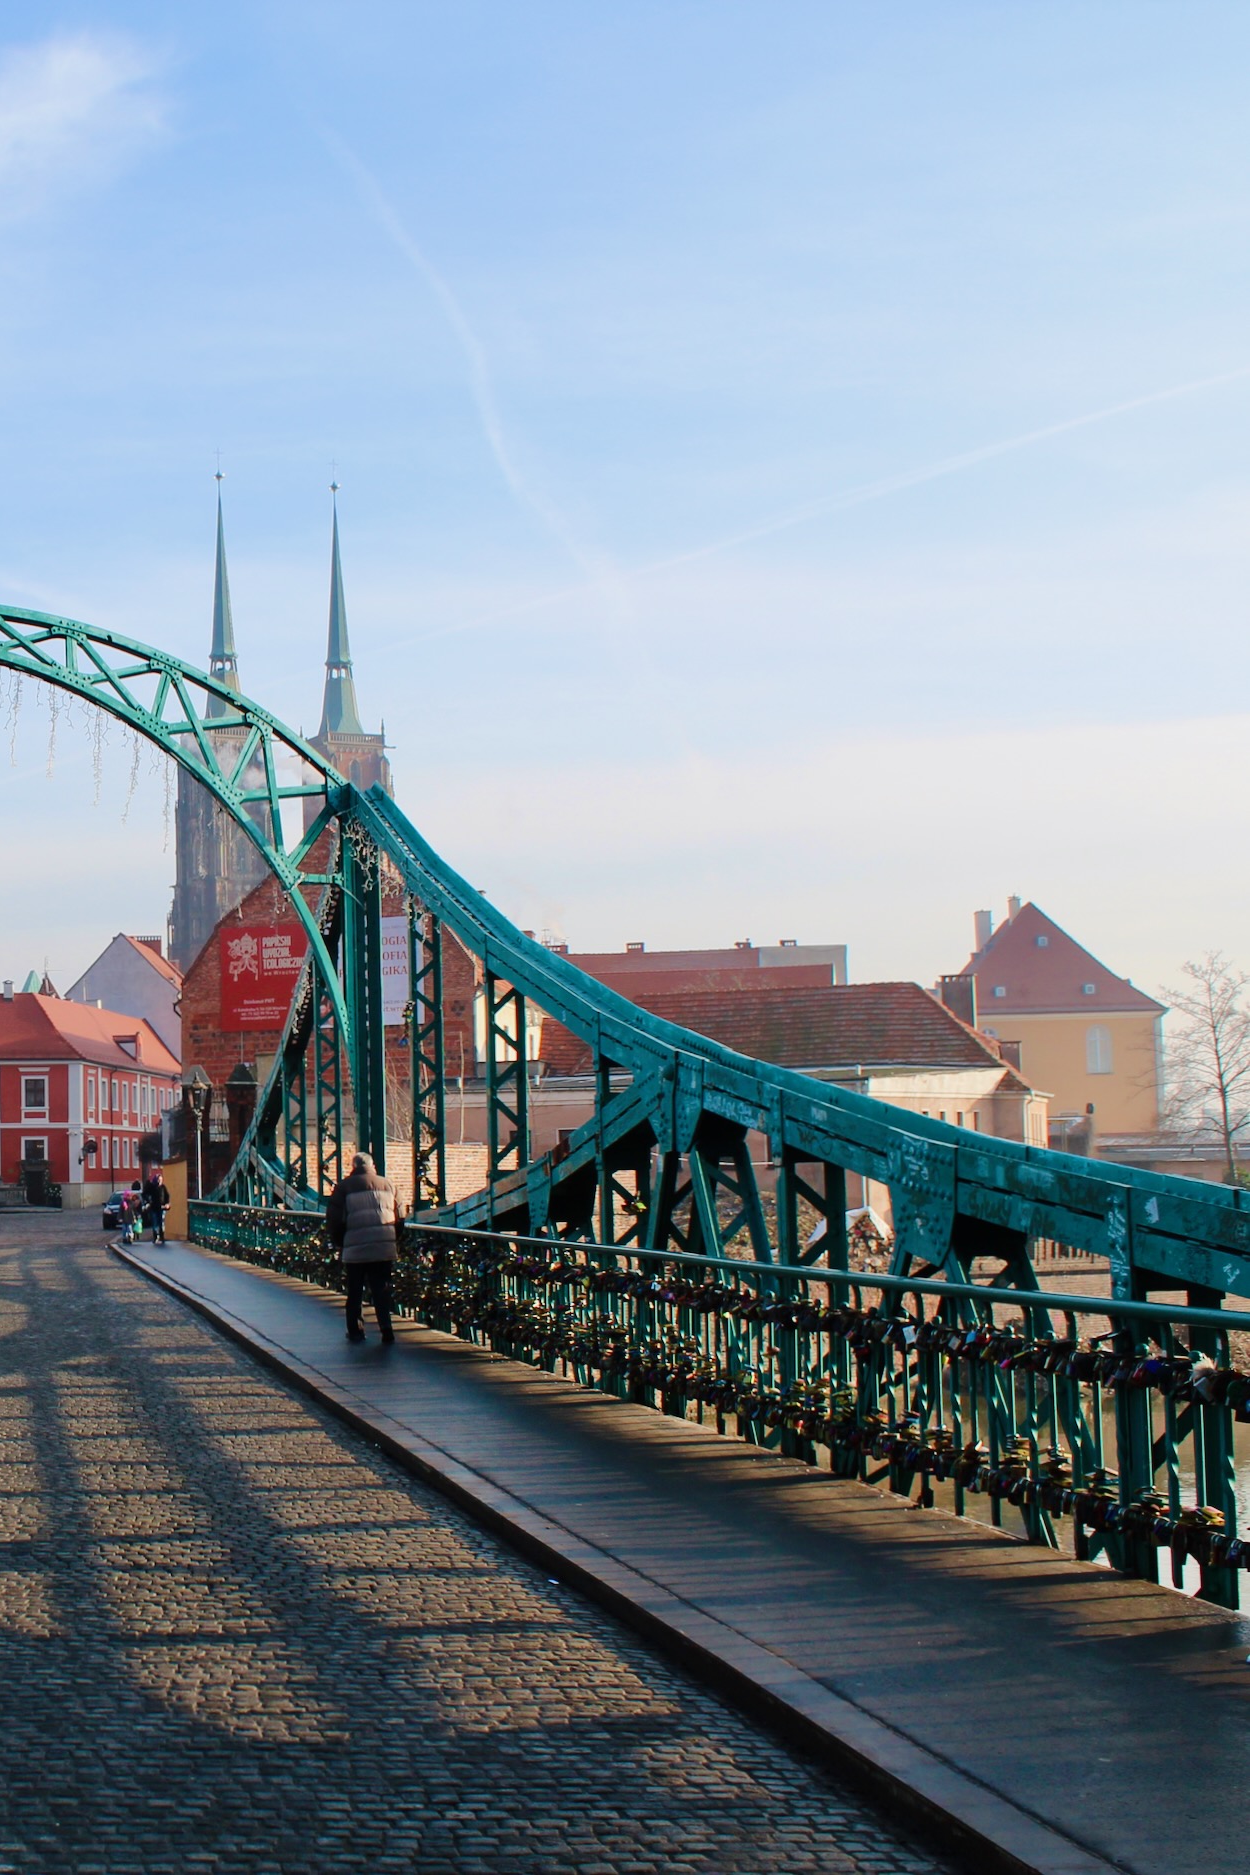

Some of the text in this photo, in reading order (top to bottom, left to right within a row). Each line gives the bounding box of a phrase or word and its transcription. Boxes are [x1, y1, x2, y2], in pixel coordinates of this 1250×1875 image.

[382, 936, 407, 946] OGIA
[382, 951, 407, 960] OFIA
[382, 965, 408, 976] GIKA
